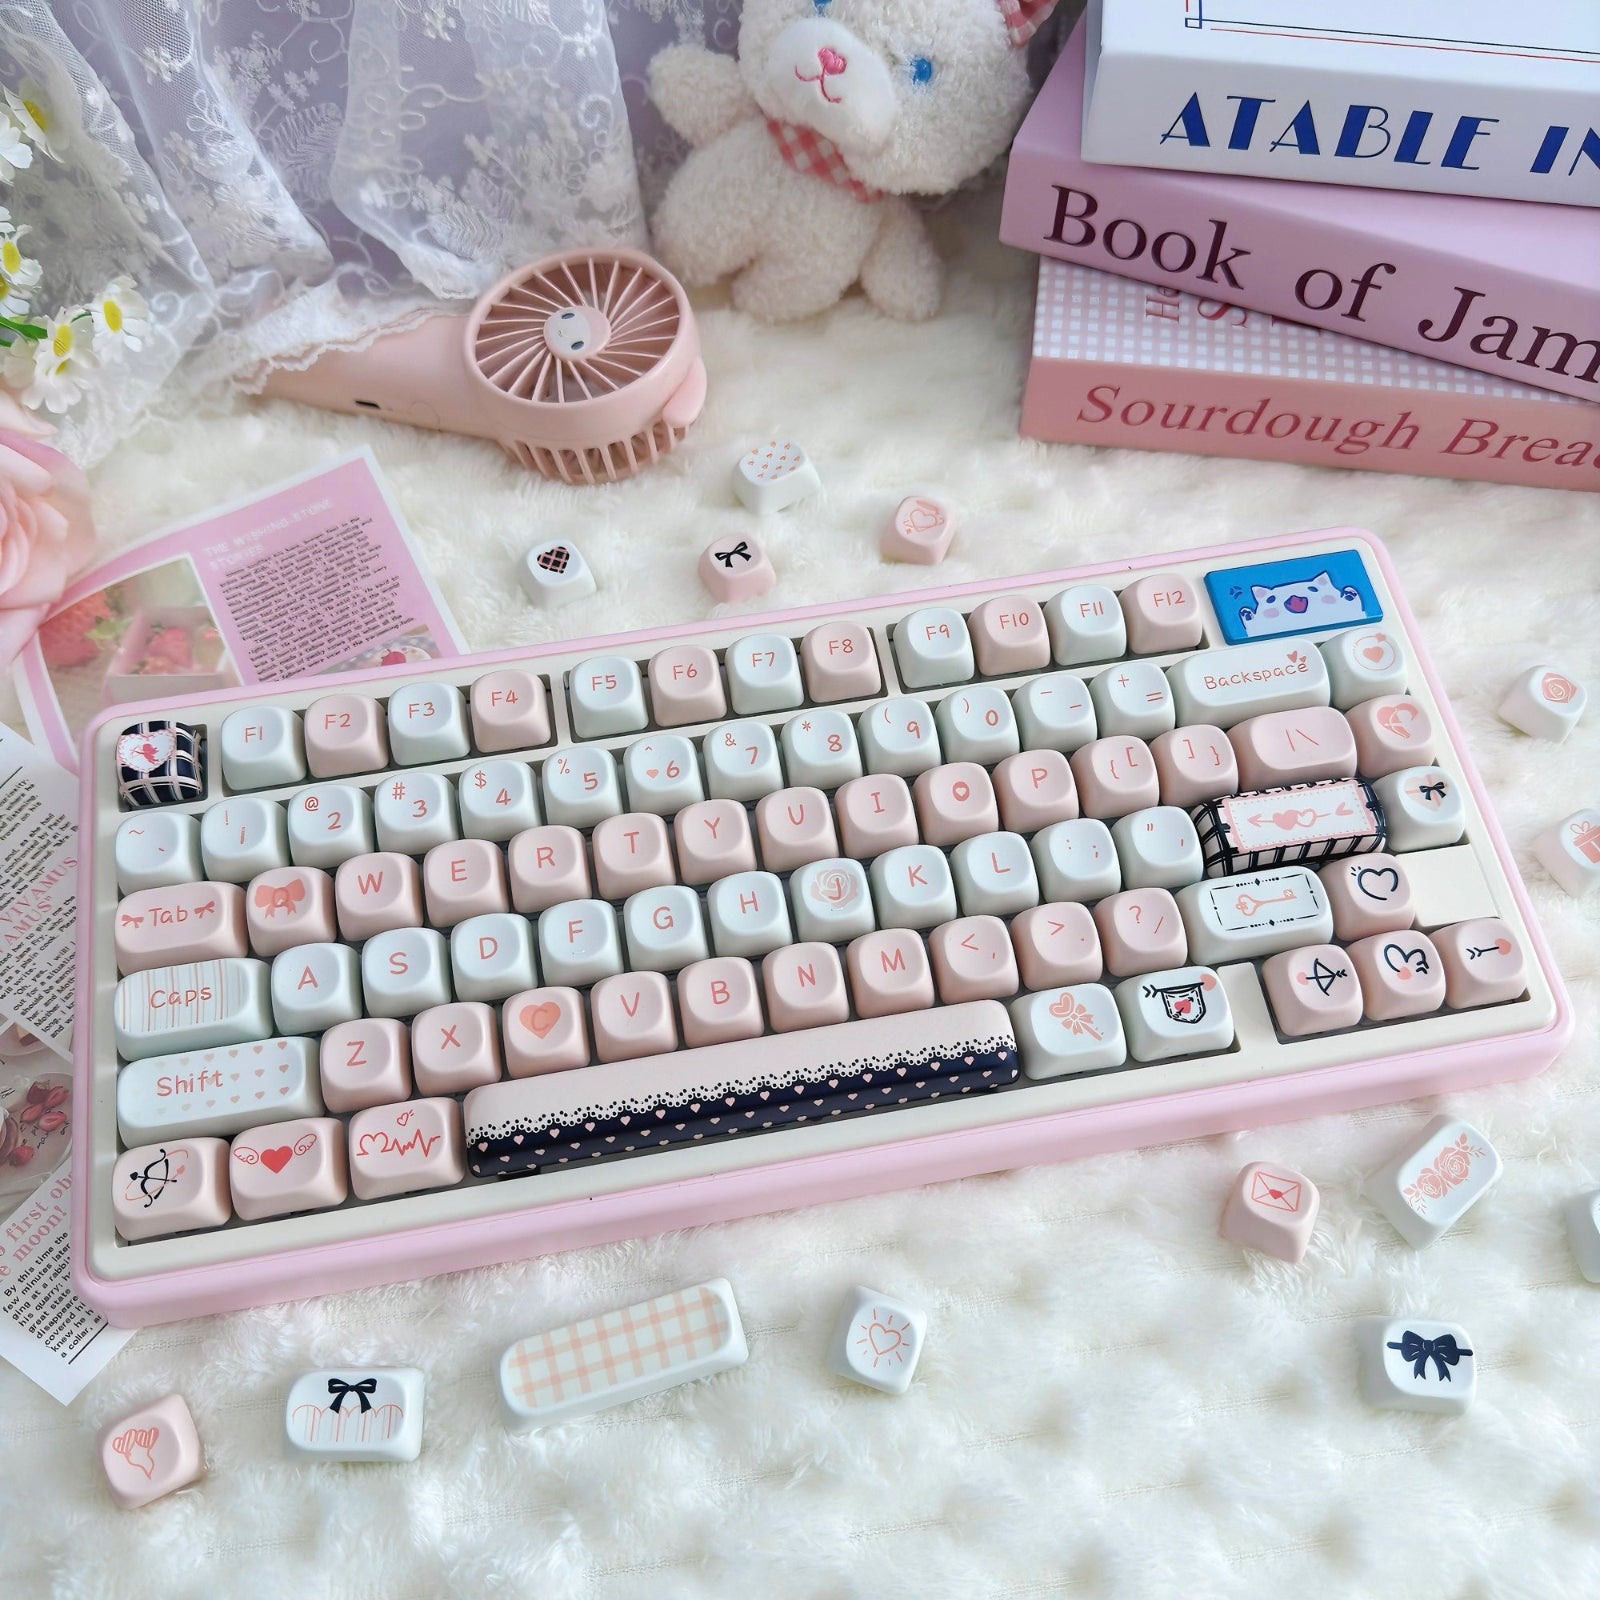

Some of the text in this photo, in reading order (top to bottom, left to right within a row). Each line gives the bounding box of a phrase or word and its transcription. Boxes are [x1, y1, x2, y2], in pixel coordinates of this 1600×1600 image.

[1160, 91, 1500, 171] ATABLE
[1044, 184, 1600, 384] Book of Jam
[1076, 385, 1600, 468] Sourdough Brea
[1079, 601, 1104, 617] F11
[1153, 590, 1184, 607] F12
[999, 611, 1030, 628] F10
[925, 624, 950, 640] F9
[828, 638, 854, 654] F8
[751, 651, 775, 667] F7
[592, 674, 617, 690] F5
[673, 664, 698, 678] F6
[1204, 660, 1308, 690] Backspace
[491, 690, 517, 705] F4
[324, 712, 350, 729] F2
[408, 701, 435, 719] F3
[984, 709, 999, 726] 0
[244, 726, 263, 742] F1
[906, 720, 920, 738] 9
[725, 732, 758, 764] & 7
[828, 734, 842, 752] 8
[557, 758, 598, 790] % 5
[666, 761, 680, 778] 6
[1031, 768, 1048, 788] P
[474, 771, 511, 805] $ 4
[28, 802, 42, 812] his
[392, 783, 427, 818] # 3
[872, 791, 884, 813] I
[304, 796, 340, 830] @ 2
[788, 804, 804, 825] U
[704, 817, 720, 839] Y
[624, 831, 639, 853] T
[536, 846, 554, 868] R
[991, 852, 1010, 874] L
[451, 859, 467, 881] E
[908, 865, 926, 887] K
[358, 871, 382, 894] W
[827, 875, 845, 900] J
[739, 891, 758, 913] H
[1129, 905, 1142, 922] ?
[149, 906, 188, 927] Tab
[653, 906, 674, 930] G
[568, 919, 583, 943] F
[478, 936, 498, 960] D
[389, 951, 408, 975] S
[881, 948, 905, 972] M
[298, 966, 317, 989] A
[798, 964, 815, 987] N
[13, 999, 27, 1011] out
[26, 987, 38, 998] for
[20, 993, 44, 1016] should
[43, 985, 54, 994] be
[43, 993, 58, 1007] and
[148, 983, 215, 1011] Caps
[711, 980, 730, 1005] B
[33, 1004, 60, 1027] Mother
[620, 992, 640, 1017] V
[530, 1006, 551, 1033] C
[50, 1024, 65, 1039] and
[441, 1025, 460, 1048] X
[347, 1040, 367, 1067] Z
[154, 1069, 225, 1099] Shift
[5, 1202, 48, 1241] first
[10, 1205, 67, 1262] moon!
[4, 1284, 17, 1297] By
[17, 1267, 35, 1283] this
[35, 1247, 54, 1265] time
[54, 1232, 68, 1245] the
[2, 1296, 20, 1313] few
[21, 1263, 52, 1295] minutes
[12, 1301, 31, 1321] ging
[31, 1290, 41, 1300] at
[28, 1289, 71, 1334] great state
[37, 1295, 79, 1339] disappeare
[18, 1313, 34, 1327] his
[45, 1301, 86, 1345] covered hi
[50, 1317, 86, 1352] knew he
